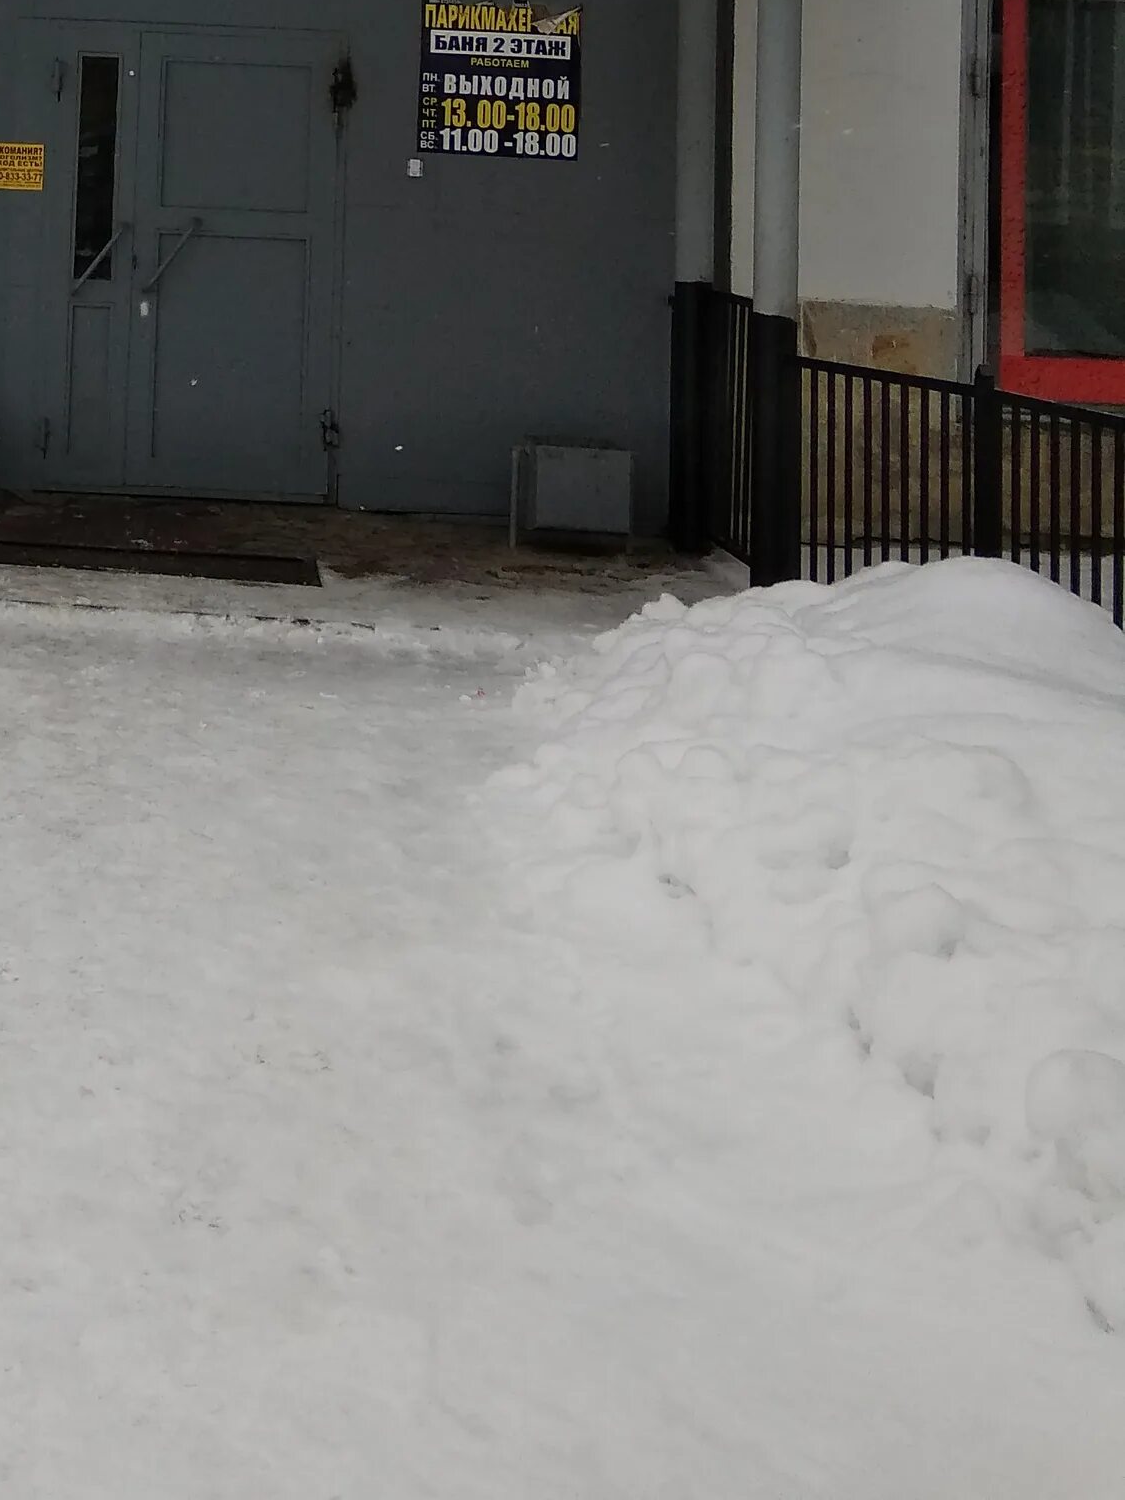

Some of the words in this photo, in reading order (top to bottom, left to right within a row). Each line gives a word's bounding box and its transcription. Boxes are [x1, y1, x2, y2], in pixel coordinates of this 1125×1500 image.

[435, 34, 488, 53] БАНЯ
[493, 37, 505, 53] 2
[510, 38, 566, 57] ЭТАЖ
[470, 57, 529, 68] РАБОТАЕМ
[444, 73, 570, 100] ВЫХОДНОЙ
